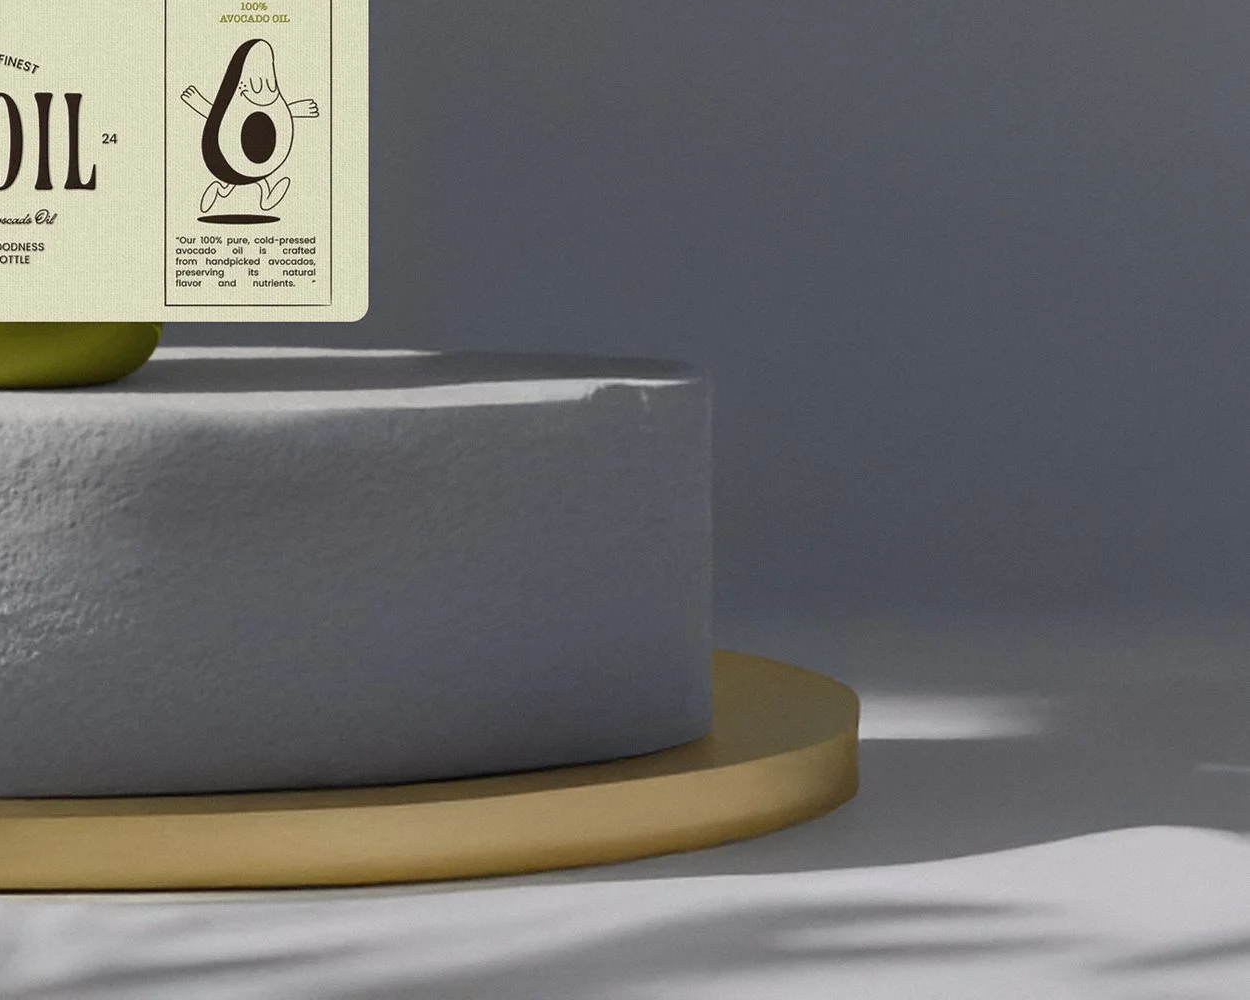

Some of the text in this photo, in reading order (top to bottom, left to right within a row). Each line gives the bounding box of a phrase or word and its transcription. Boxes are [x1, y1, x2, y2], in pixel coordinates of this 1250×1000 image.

[240, 2, 268, 11] 100%
[219, 14, 291, 24] AVOCADO OIL
[101, 133, 118, 144] 24
[35, 209, 57, 225] Oil
[200, 236, 222, 244] 100%
[227, 237, 250, 246] pure,
[254, 236, 316, 246] cold-pressed
[176, 247, 316, 255] avocado oil is crafted
[176, 258, 316, 267] from handpicked avocados,
[176, 269, 224, 278] preserving
[248, 268, 258, 276] its
